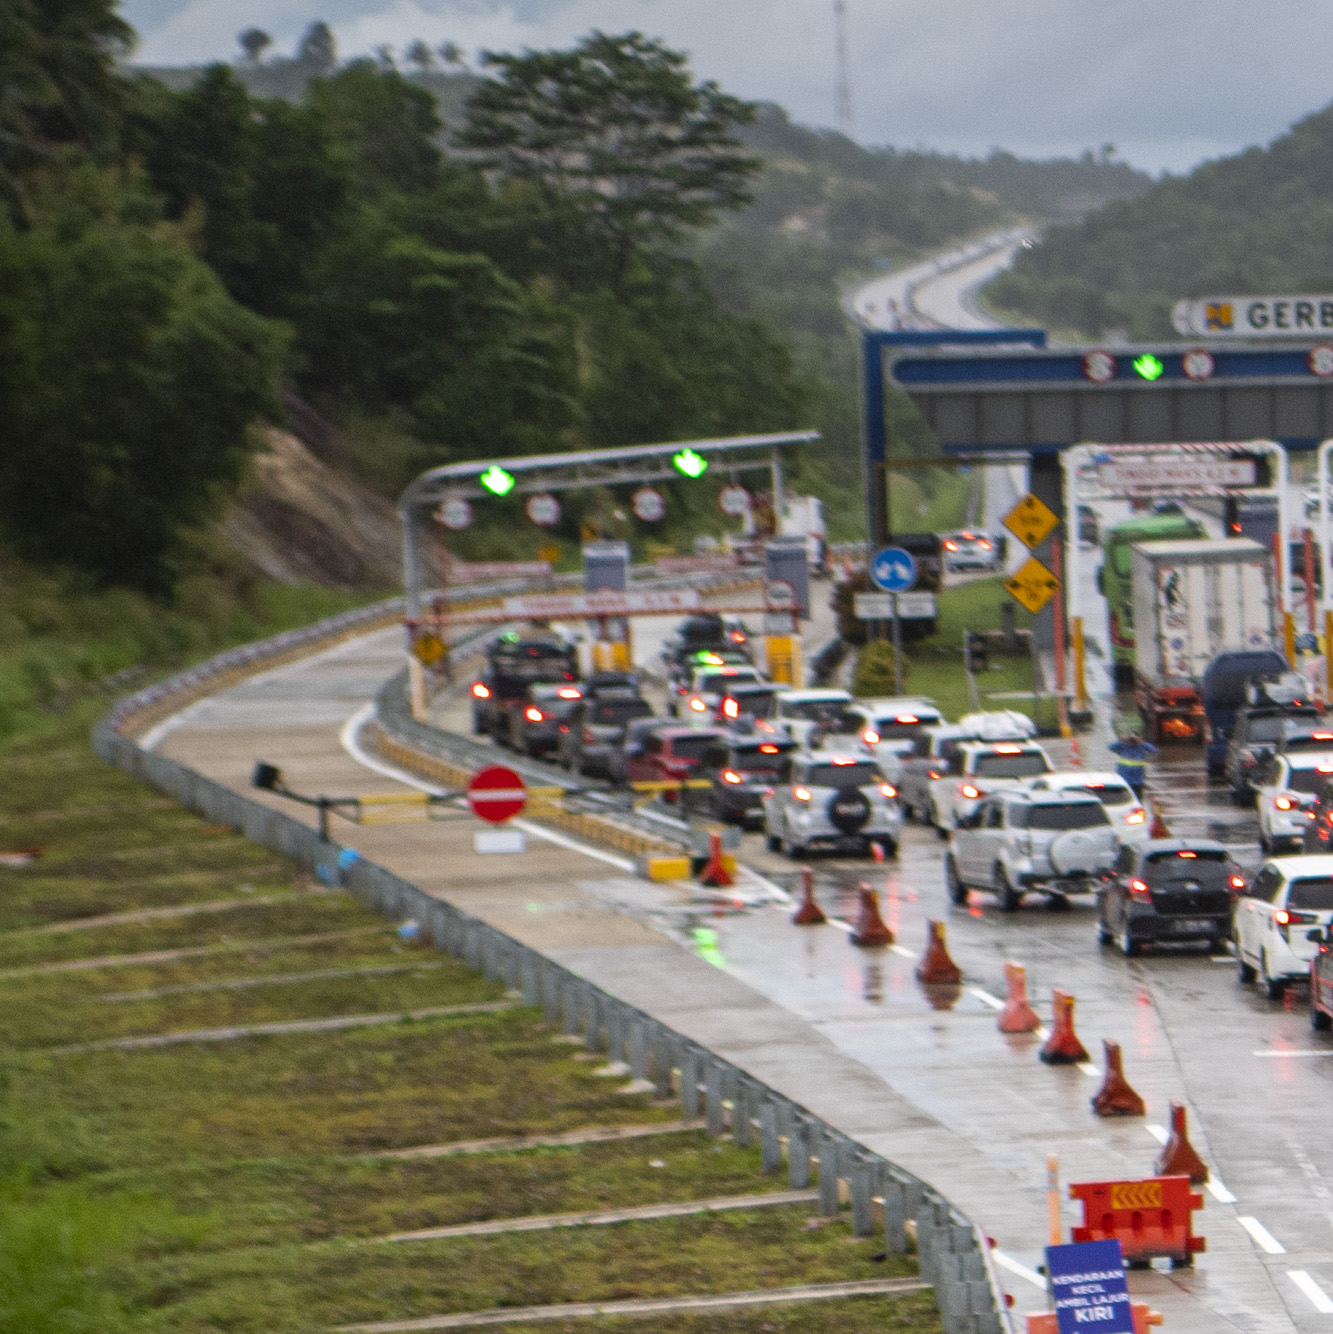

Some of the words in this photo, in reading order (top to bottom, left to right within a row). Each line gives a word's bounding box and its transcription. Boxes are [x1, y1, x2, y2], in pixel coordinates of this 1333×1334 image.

[1052, 1269, 1124, 1286] KENDARAAN
[1071, 1283, 1105, 1296] KECIL
[1056, 1297, 1090, 1309] AMBIL
[1091, 1293, 1130, 1305] LAJUR
[1073, 1305, 1116, 1323] KIRI
